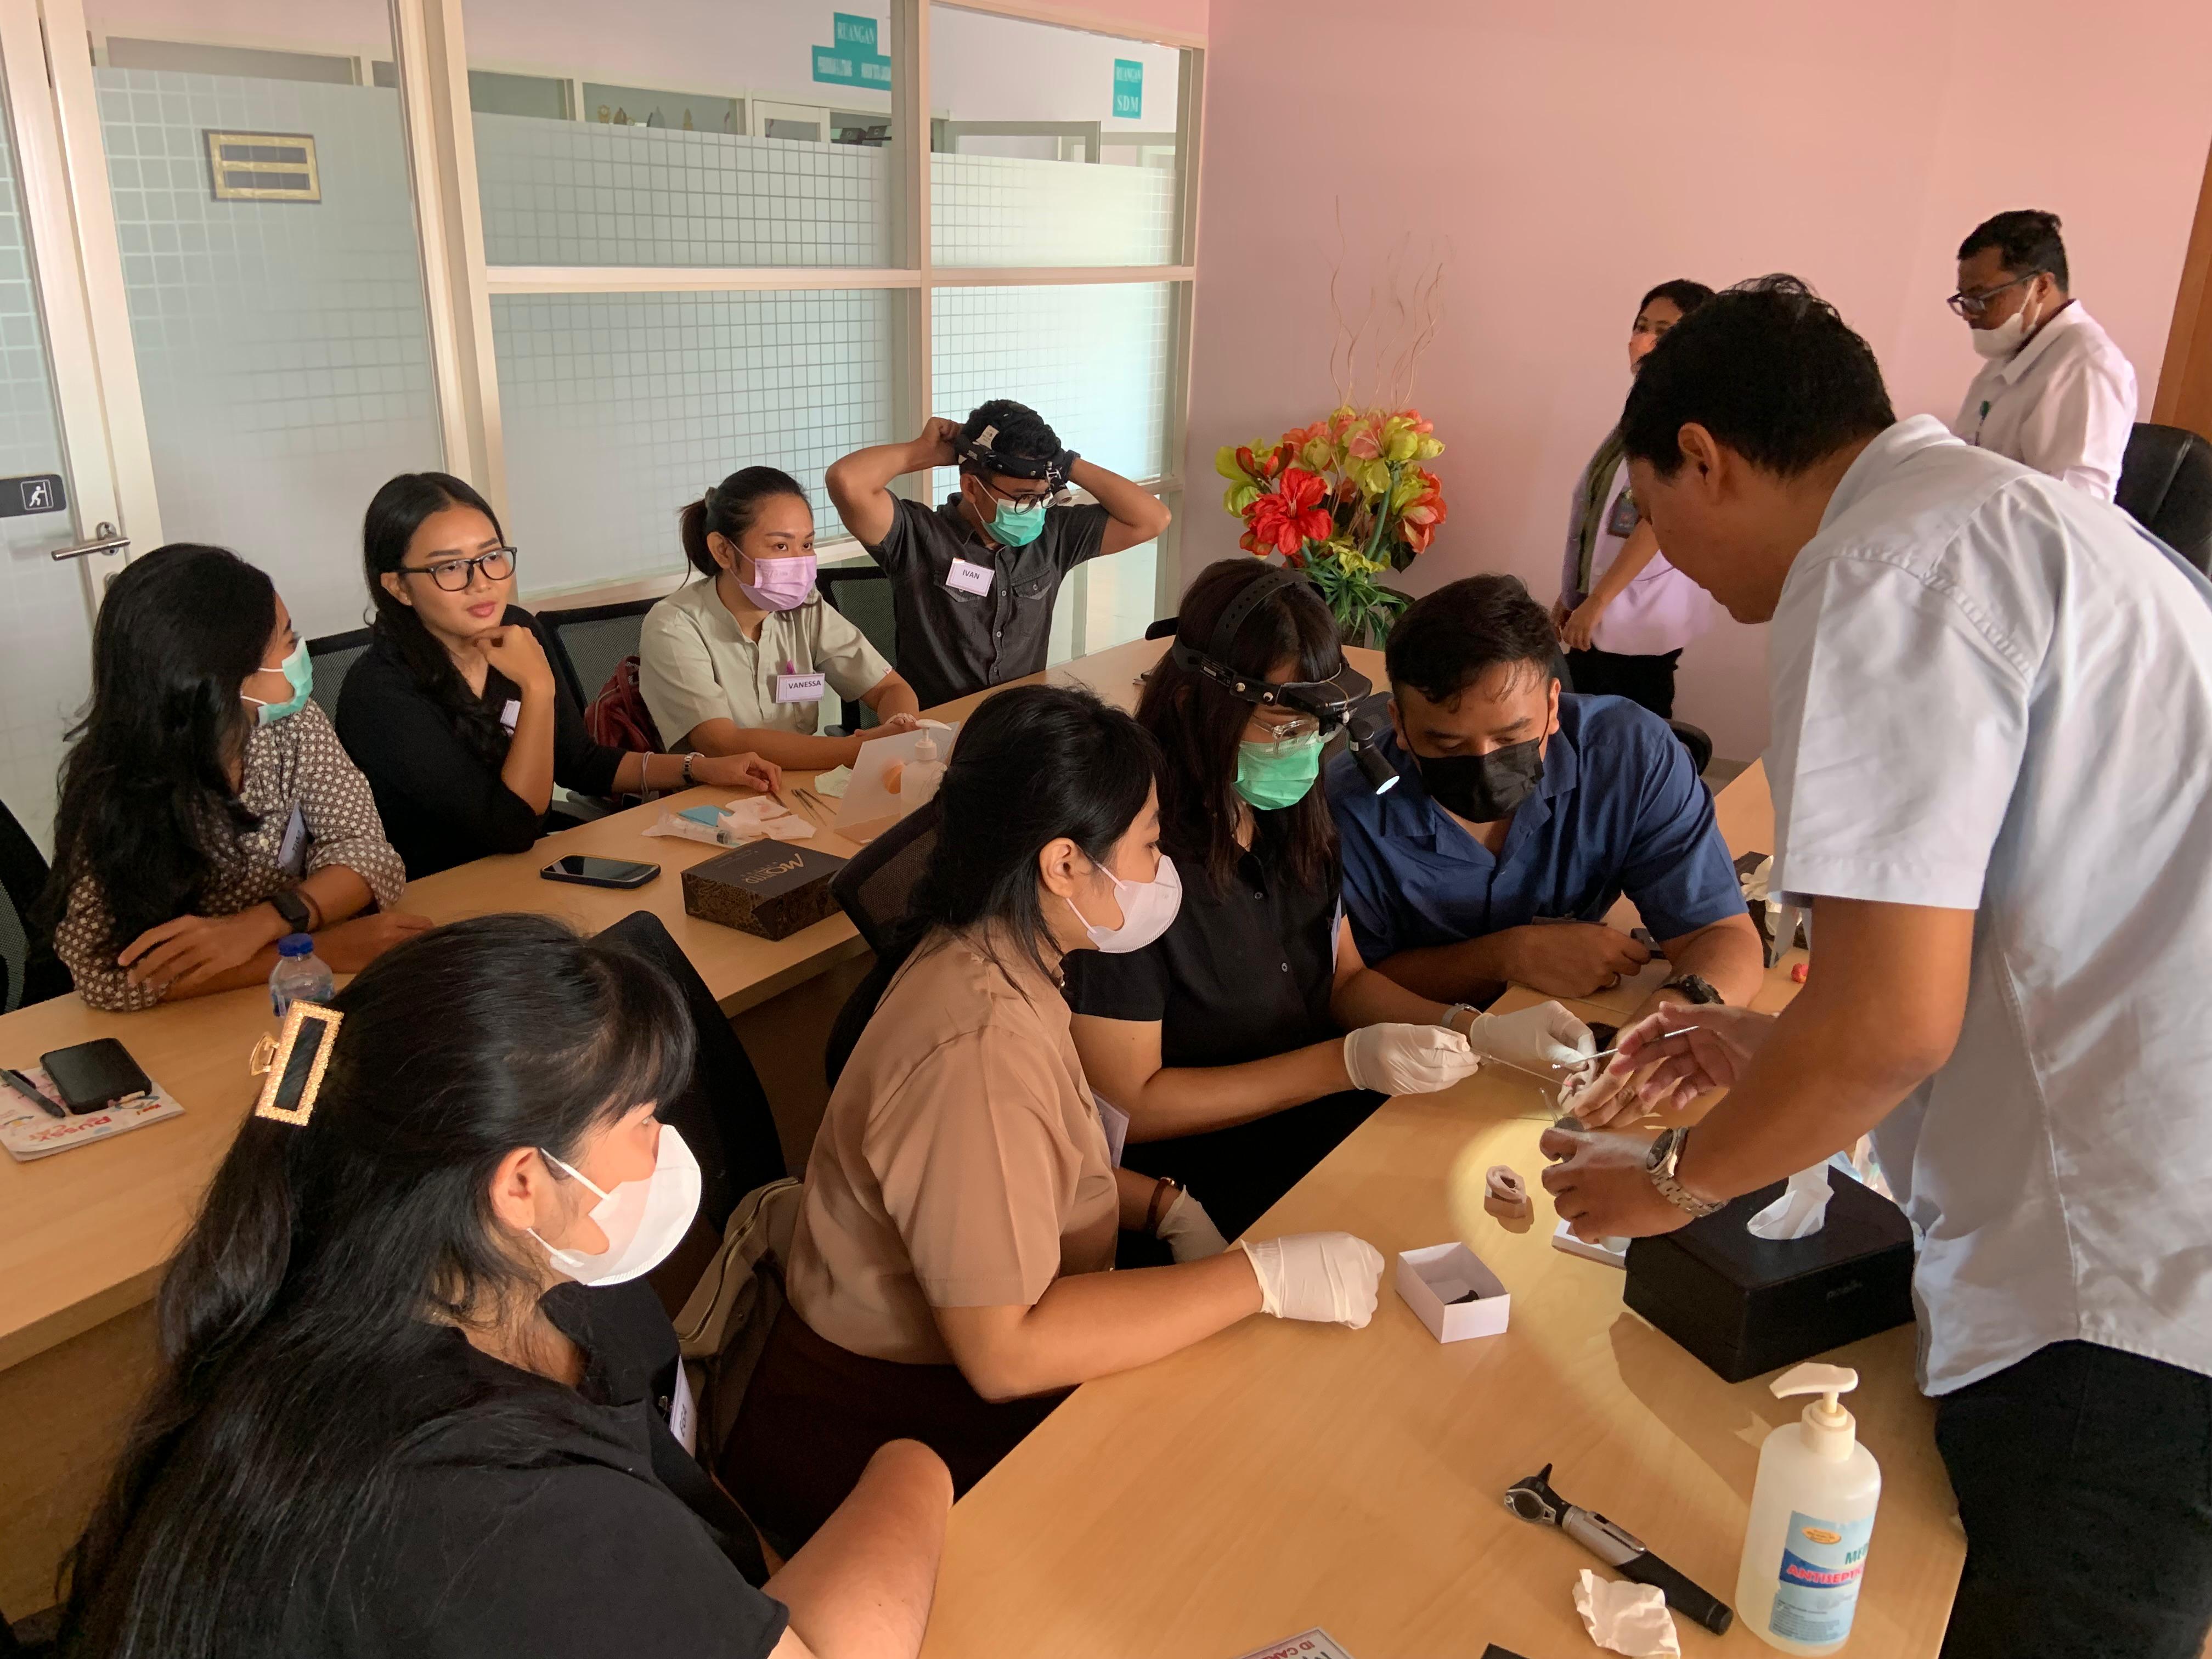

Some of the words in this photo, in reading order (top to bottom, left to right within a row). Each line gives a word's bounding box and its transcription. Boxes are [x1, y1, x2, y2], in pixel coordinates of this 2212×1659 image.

[837, 22, 874, 45] RUANGAN
[1117, 94, 1139, 112] SDM
[962, 569, 980, 580] IVAN
[788, 680, 821, 689] VANESSA
[1786, 1564, 1862, 1584] ANTISEPTI
[1299, 1640, 1316, 1651] ID
